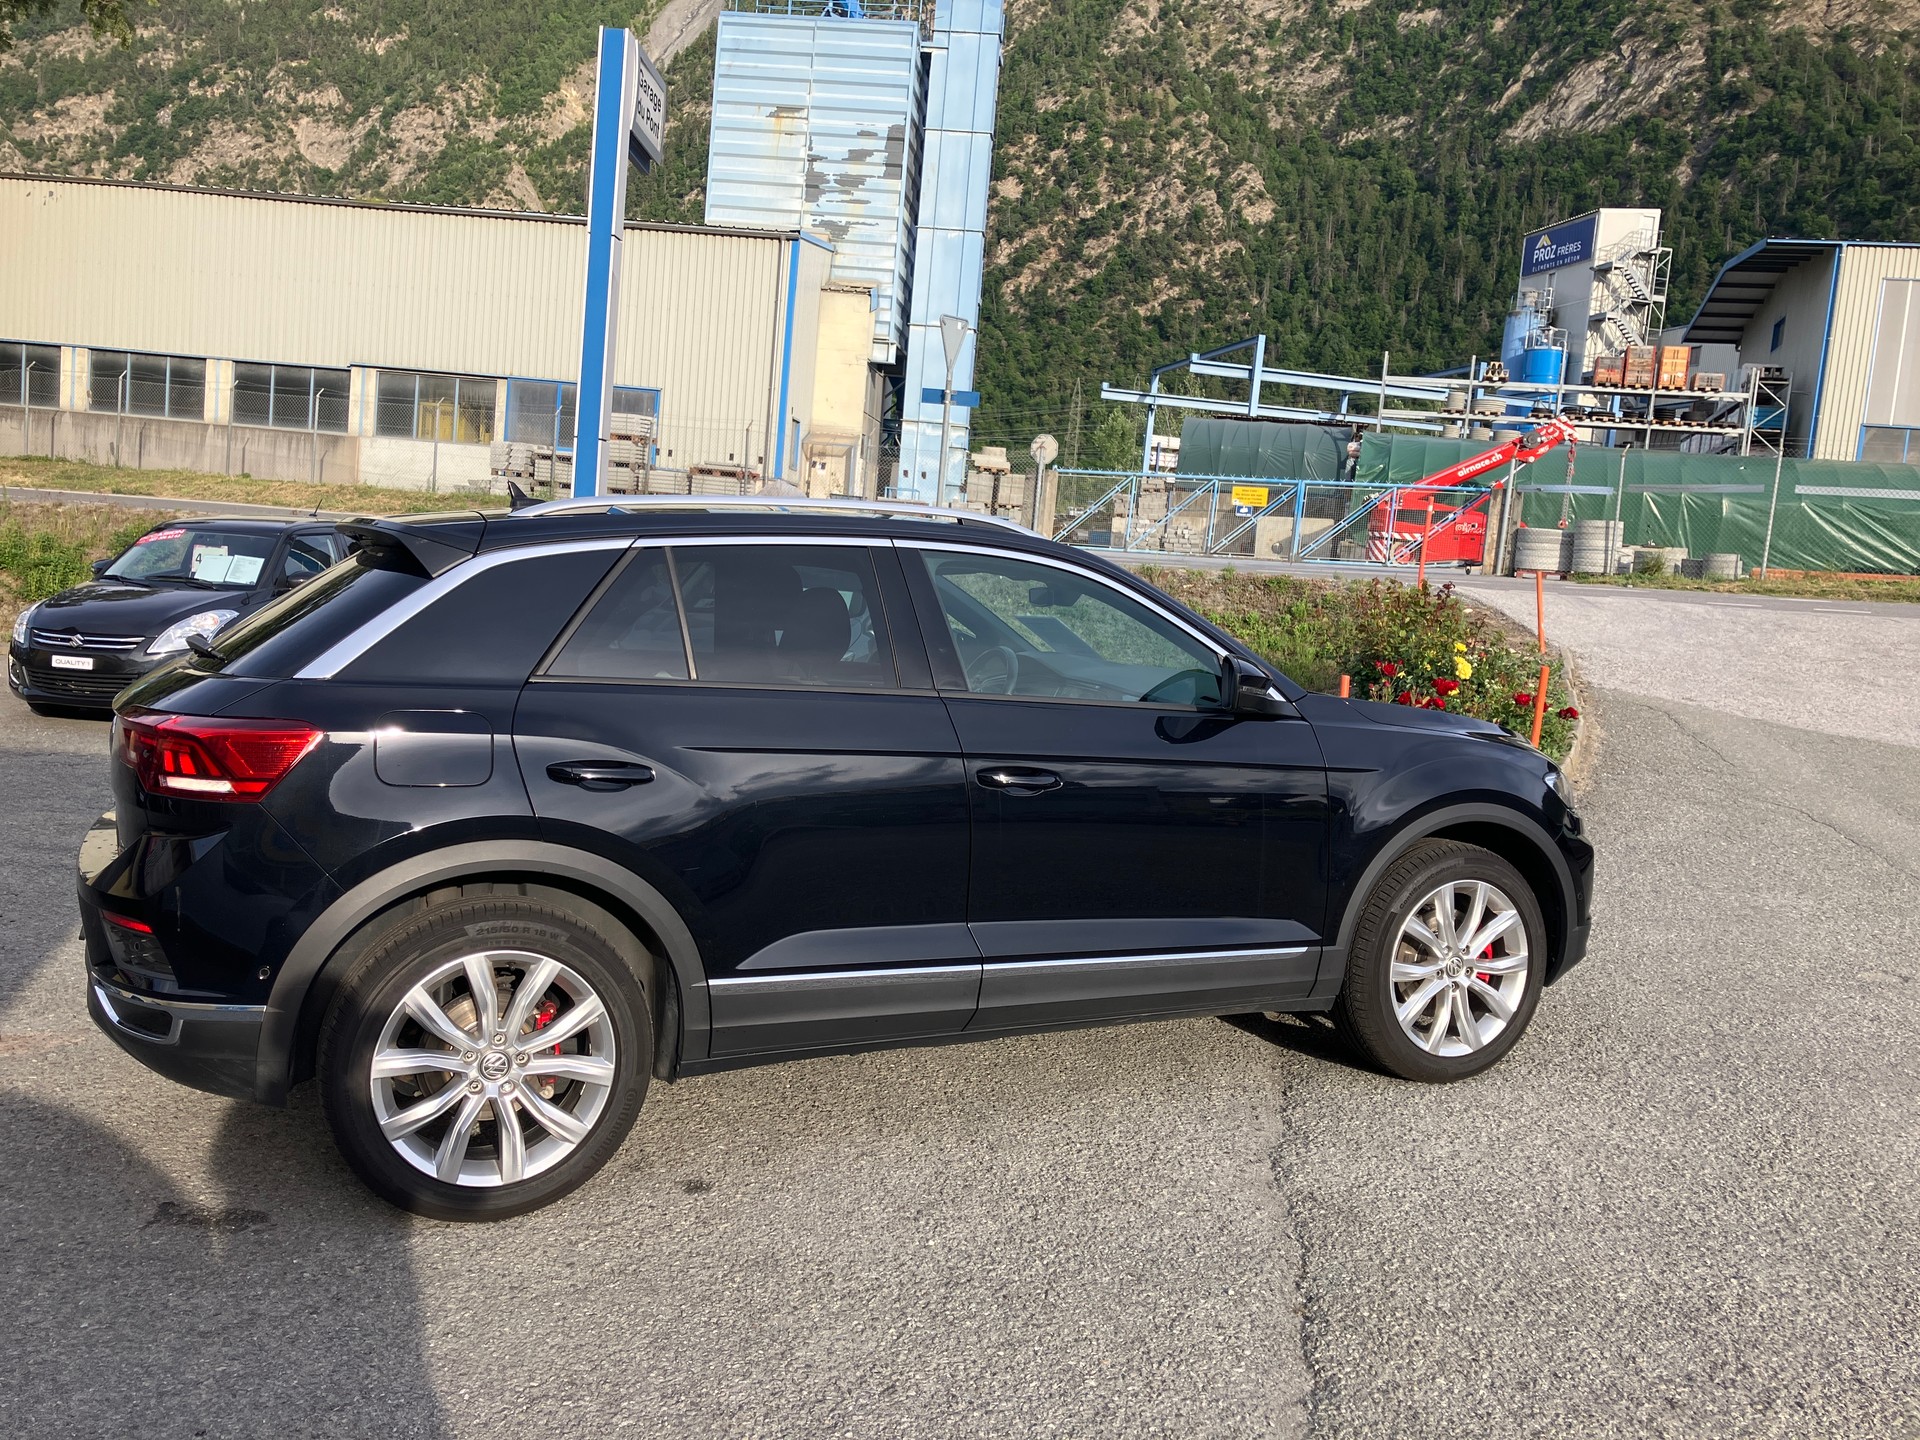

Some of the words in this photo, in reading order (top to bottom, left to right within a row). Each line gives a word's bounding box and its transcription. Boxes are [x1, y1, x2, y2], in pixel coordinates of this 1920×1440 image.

[639, 68, 662, 112] Garage
[637, 99, 645, 121] du
[645, 108, 660, 140] Pont
[1533, 244, 1556, 263] PROZ
[1557, 241, 1582, 257] FRÈRES
[1457, 452, 1503, 477] airnace.ch
[55, 658, 86, 667] QUALITY
[476, 926, 519, 936] 215/50
[522, 926, 531, 934] R
[534, 928, 547, 936] 18
